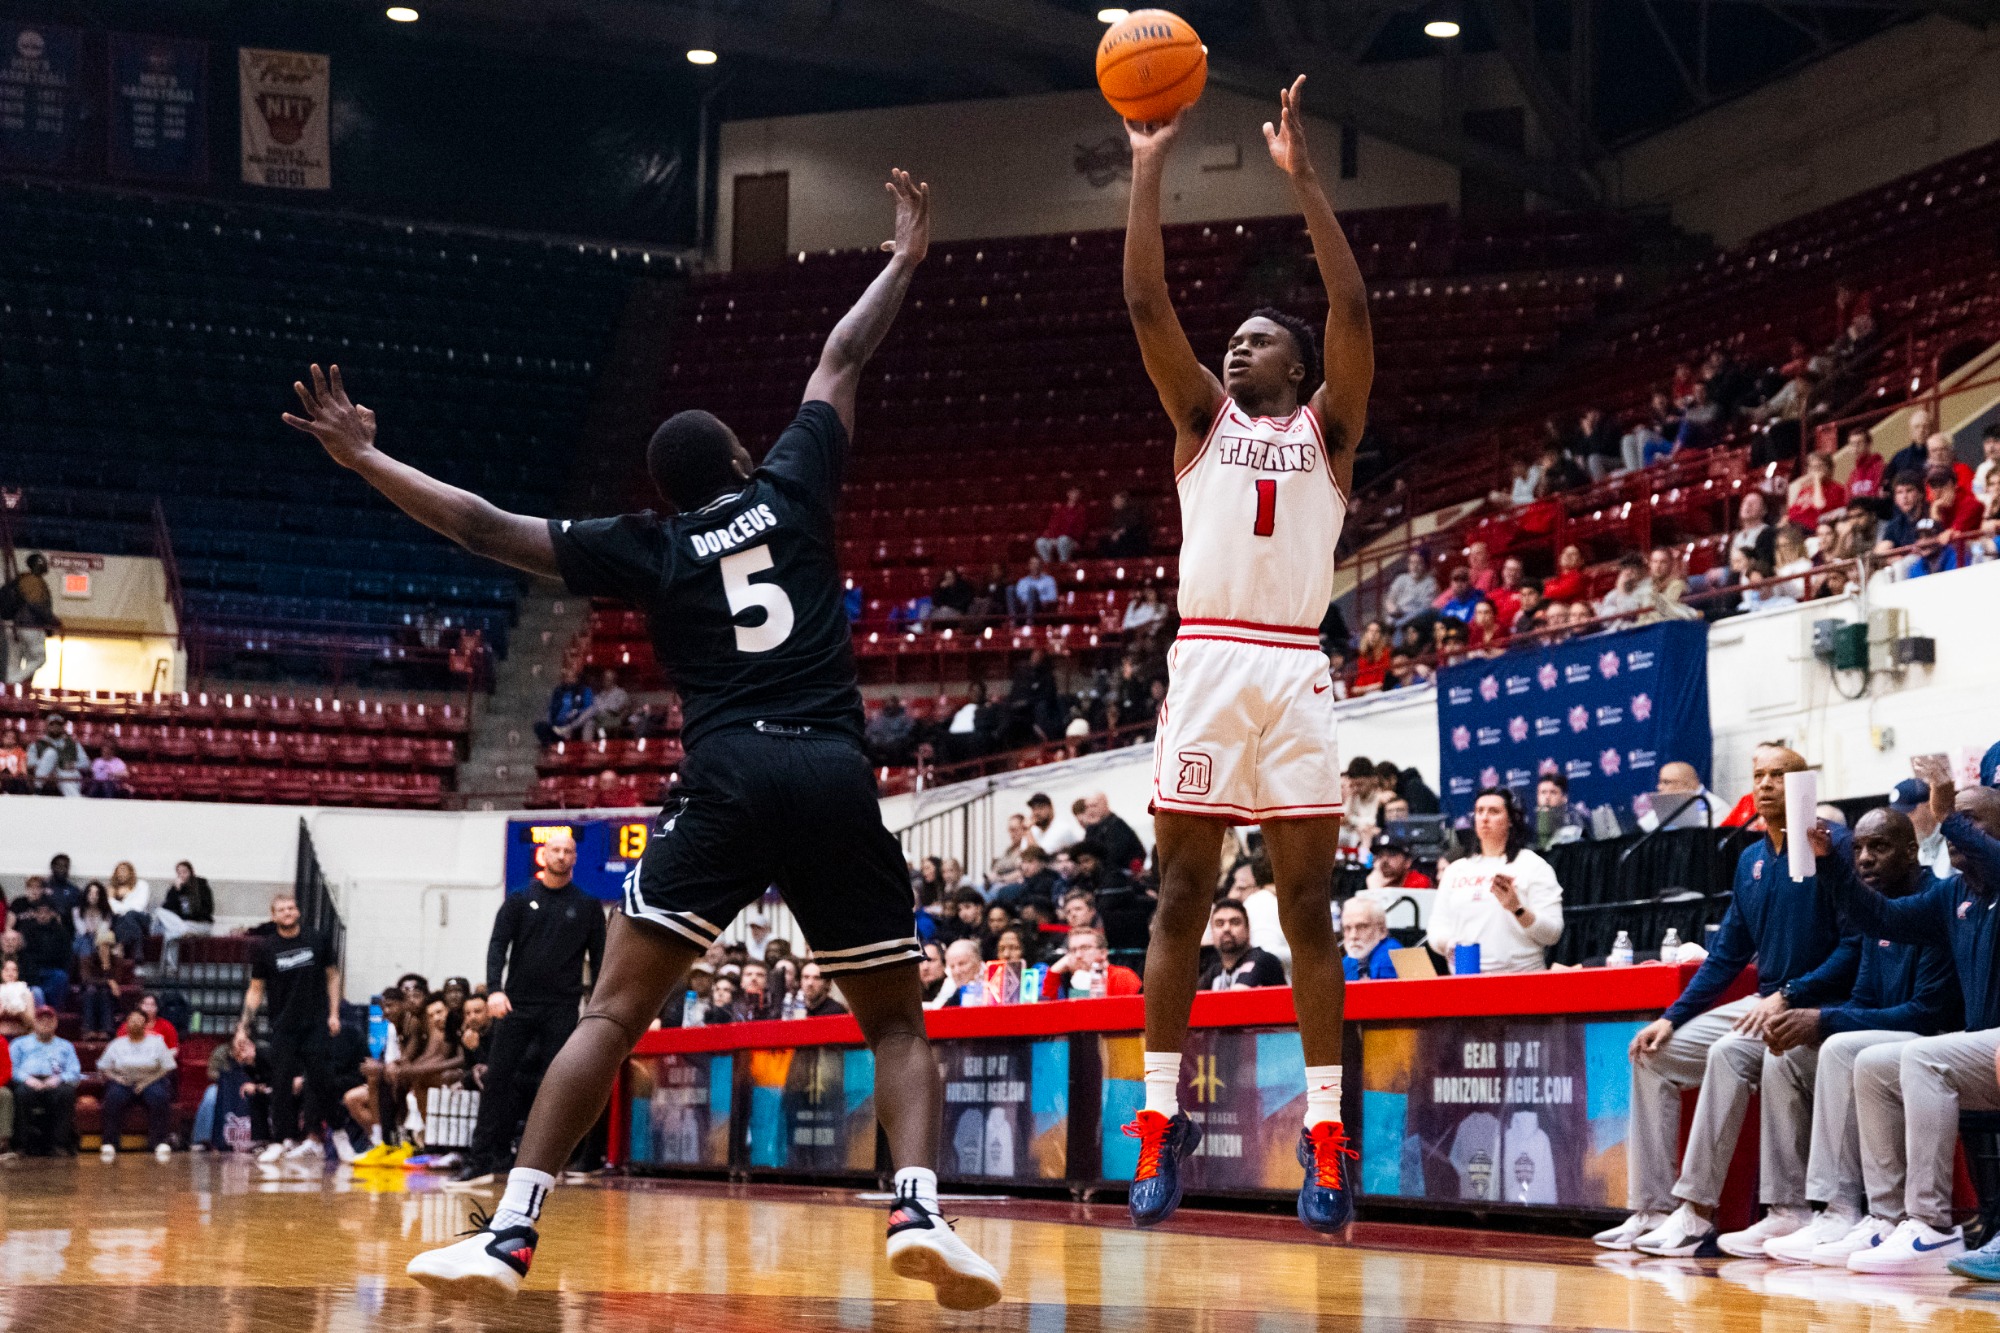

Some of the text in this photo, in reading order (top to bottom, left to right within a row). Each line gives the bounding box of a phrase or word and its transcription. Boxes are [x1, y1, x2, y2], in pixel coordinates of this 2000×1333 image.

[1220, 436, 1316, 472] TITANS
[690, 503, 778, 557] DORCEUS
[1254, 479, 1277, 537] 1
[720, 543, 795, 653] 5
[1463, 1041, 1541, 1069] GEAR UP AT
